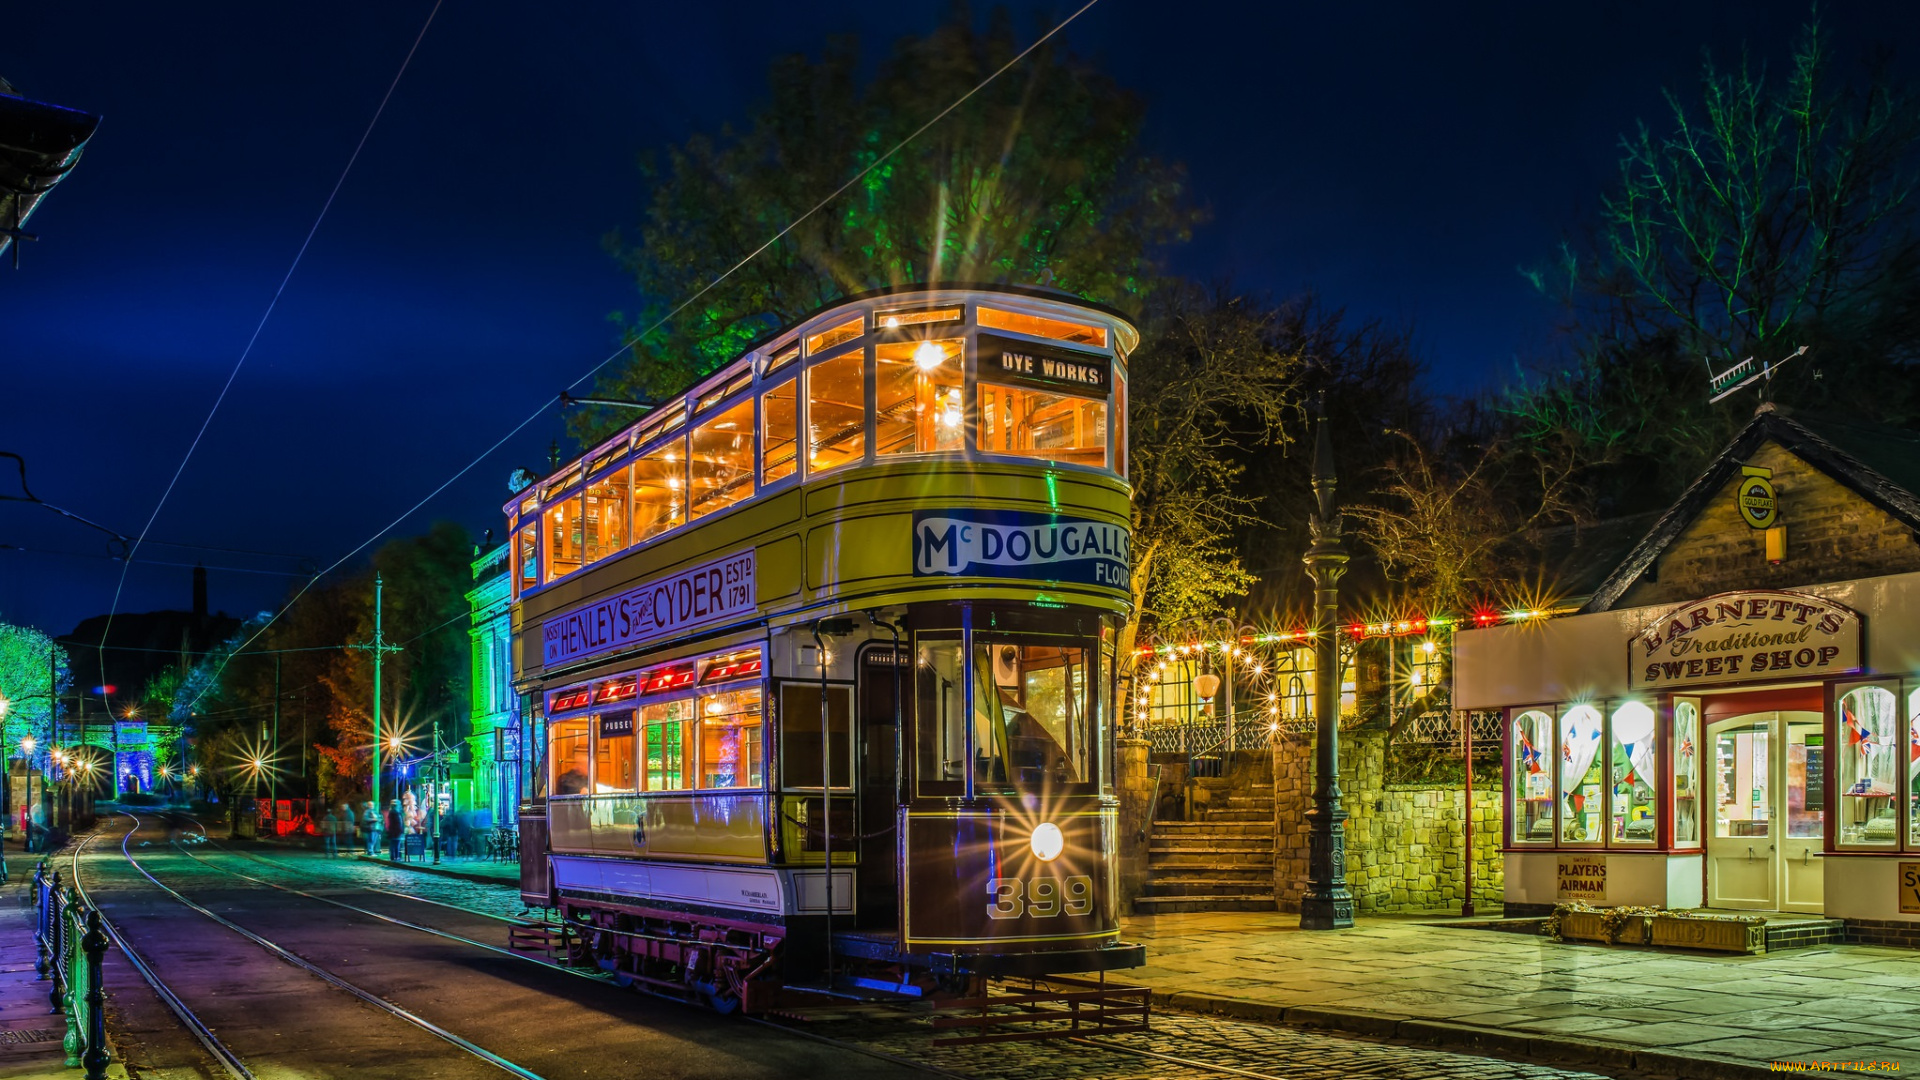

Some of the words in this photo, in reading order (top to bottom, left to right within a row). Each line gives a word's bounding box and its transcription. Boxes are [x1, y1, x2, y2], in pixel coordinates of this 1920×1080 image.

[1002, 351, 1033, 374] DYE
[1043, 358, 1099, 384] WORKS
[1745, 497, 1757, 506] GOLD
[1758, 499, 1773, 508] FLAKE
[1095, 561, 1130, 590] FLOUR
[560, 597, 632, 656] HENLEY'S
[632, 591, 653, 633] FAMOUS
[652, 567, 724, 628] CYDER
[728, 583, 751, 609] 1791
[544, 622, 561, 643] INSIST
[1641, 597, 1845, 658] BARNETT'S
[1669, 623, 1813, 657] Traditional
[549, 643, 558, 660] ON
[1644, 654, 1744, 682] SWEET
[1750, 645, 1840, 672] SHOP
[1559, 863, 1606, 876] PLAYER'S
[986, 874, 1093, 921] 399
